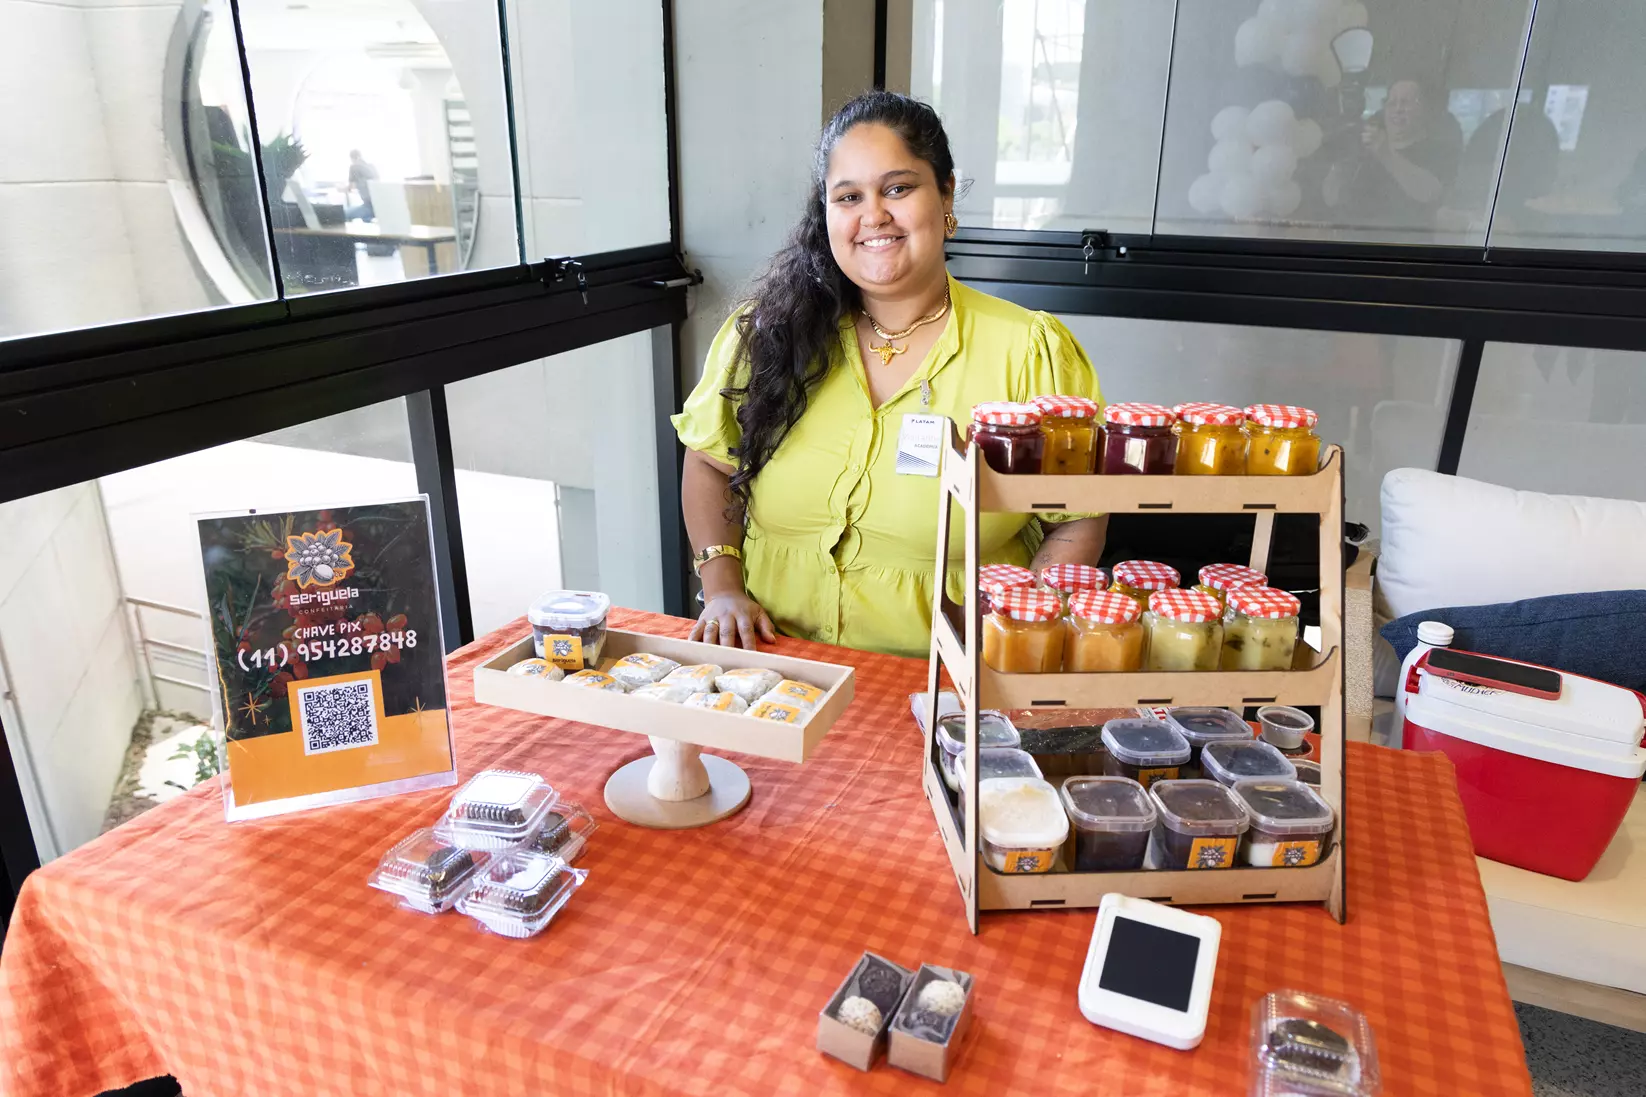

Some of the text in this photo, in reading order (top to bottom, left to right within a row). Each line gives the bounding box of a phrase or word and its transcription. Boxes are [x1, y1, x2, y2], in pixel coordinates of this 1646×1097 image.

[290, 587, 359, 605] seriguela
[299, 604, 353, 615] CONFEITARIA
[295, 620, 361, 639] CHAVE PIX
[238, 630, 417, 672] (11) 954287848
